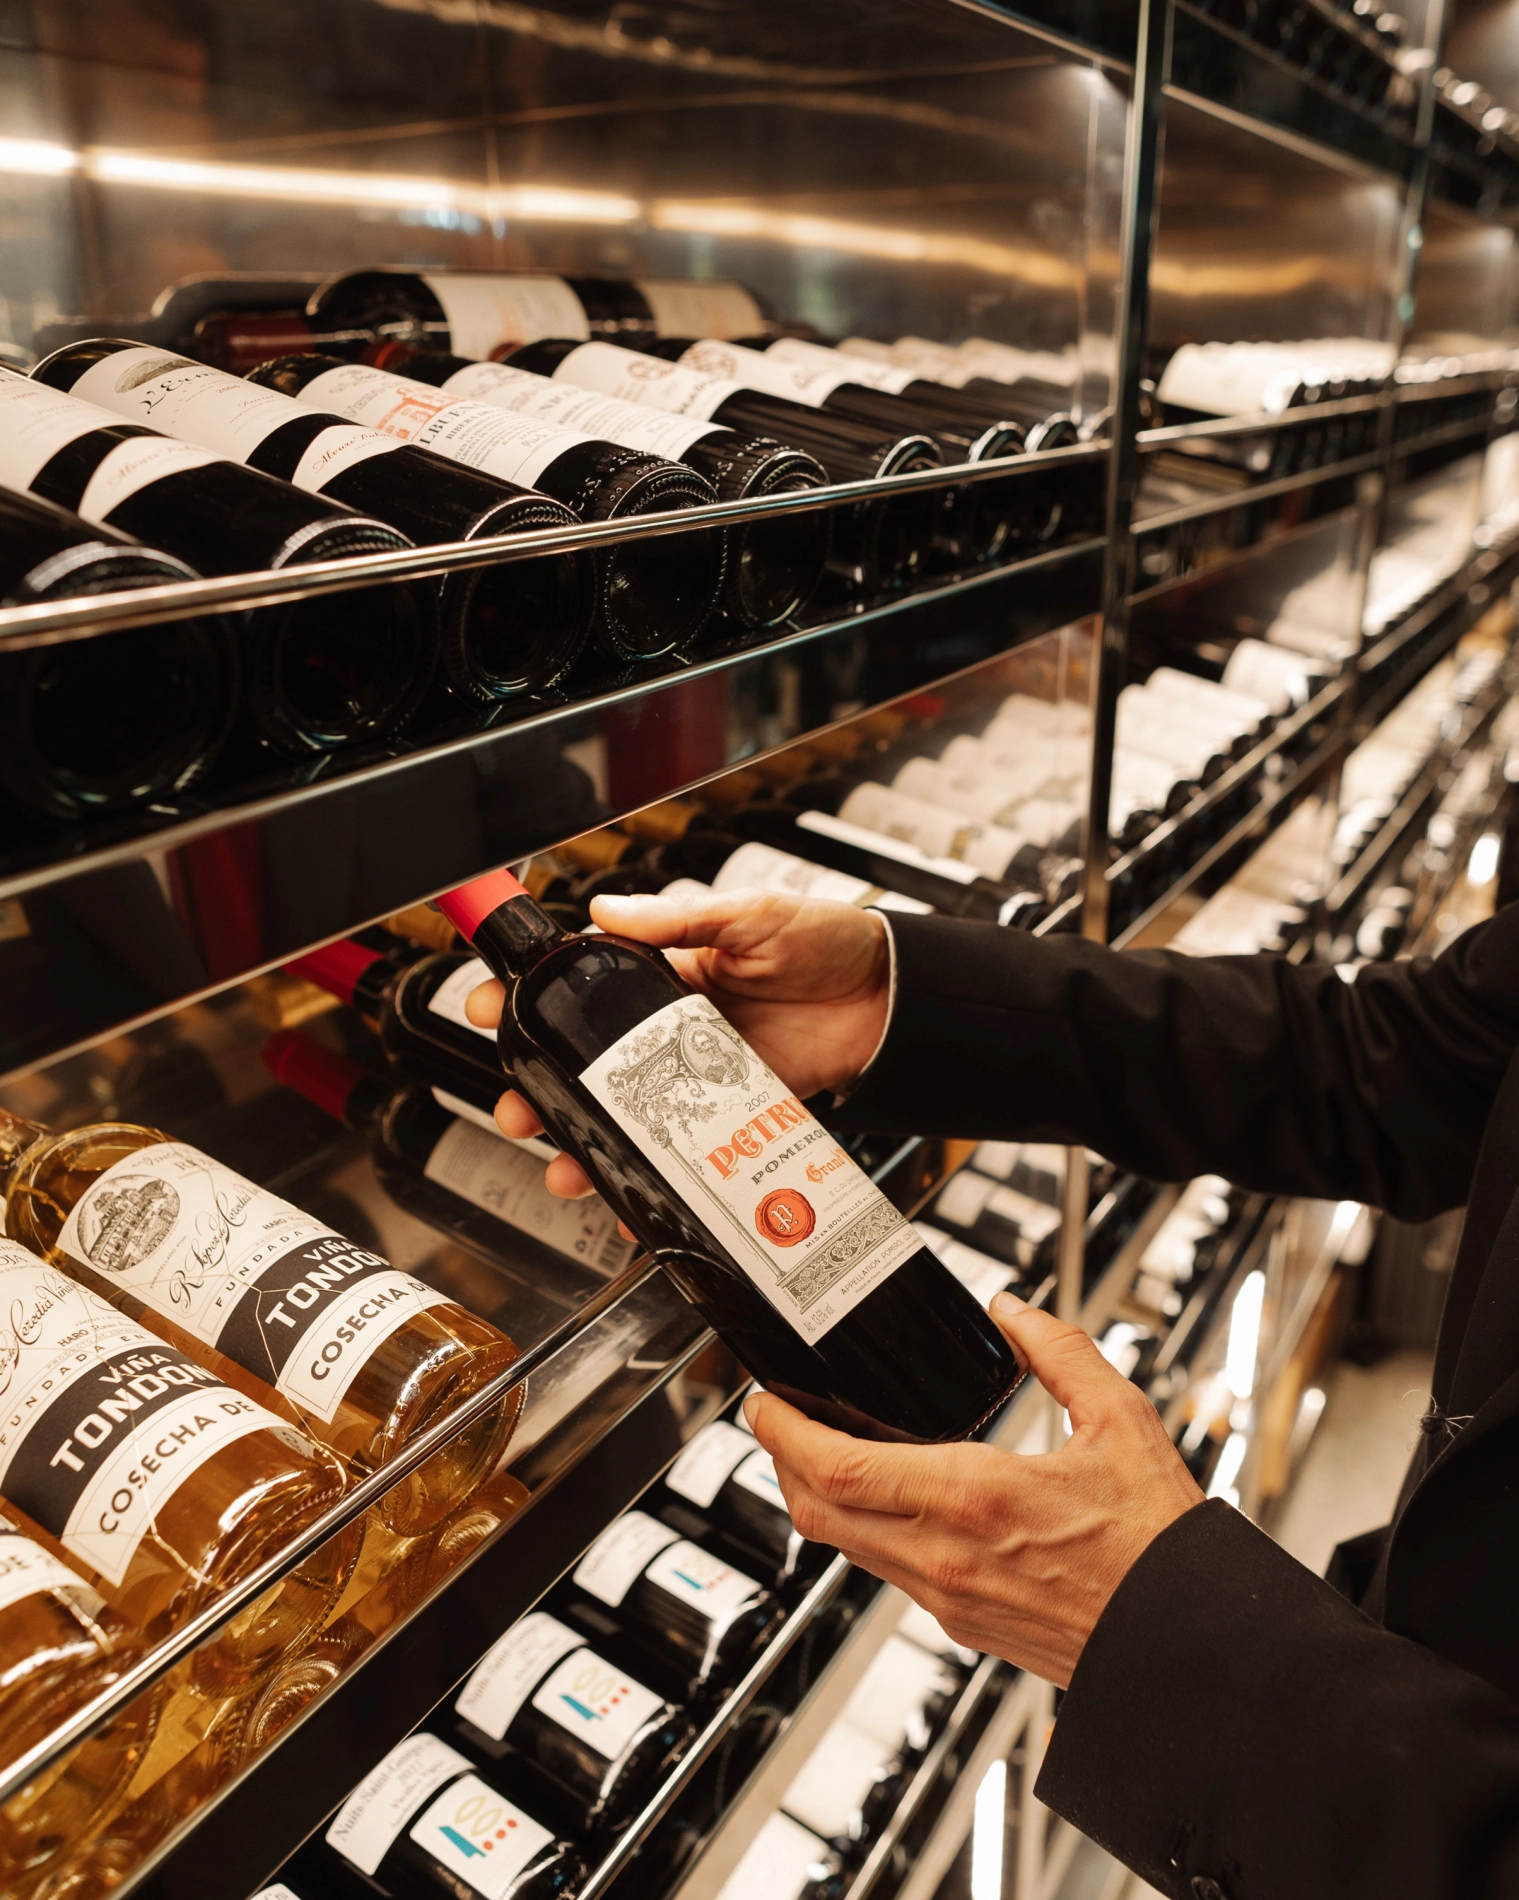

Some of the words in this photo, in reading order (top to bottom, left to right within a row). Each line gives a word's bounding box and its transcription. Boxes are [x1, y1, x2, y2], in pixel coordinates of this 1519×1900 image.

[744, 1091, 770, 1112] 2007
[704, 1096, 816, 1181] PETRU
[751, 1128, 828, 1185] POMEROL
[262, 1218, 287, 1231] HARO
[303, 1239, 359, 1261] VIÑA
[805, 1235, 820, 1249] MIS
[820, 1229, 828, 1237] EN
[828, 1199, 863, 1230] BOUTEILLES
[215, 1230, 303, 1308] FUNDADA
[265, 1251, 391, 1329] TONDO
[840, 1258, 881, 1295] APPELLATION
[881, 1240, 905, 1260] POMEROL
[57, 1329, 89, 1347] HARO
[310, 1286, 410, 1381] COSECHA
[0, 1345, 106, 1446] FUNDADA
[98, 1353, 172, 1384] VIÑA
[50, 1364, 226, 1473] TONDON
[99, 1414, 218, 1535] COSECHA
[218, 1401, 256, 1416] DE
